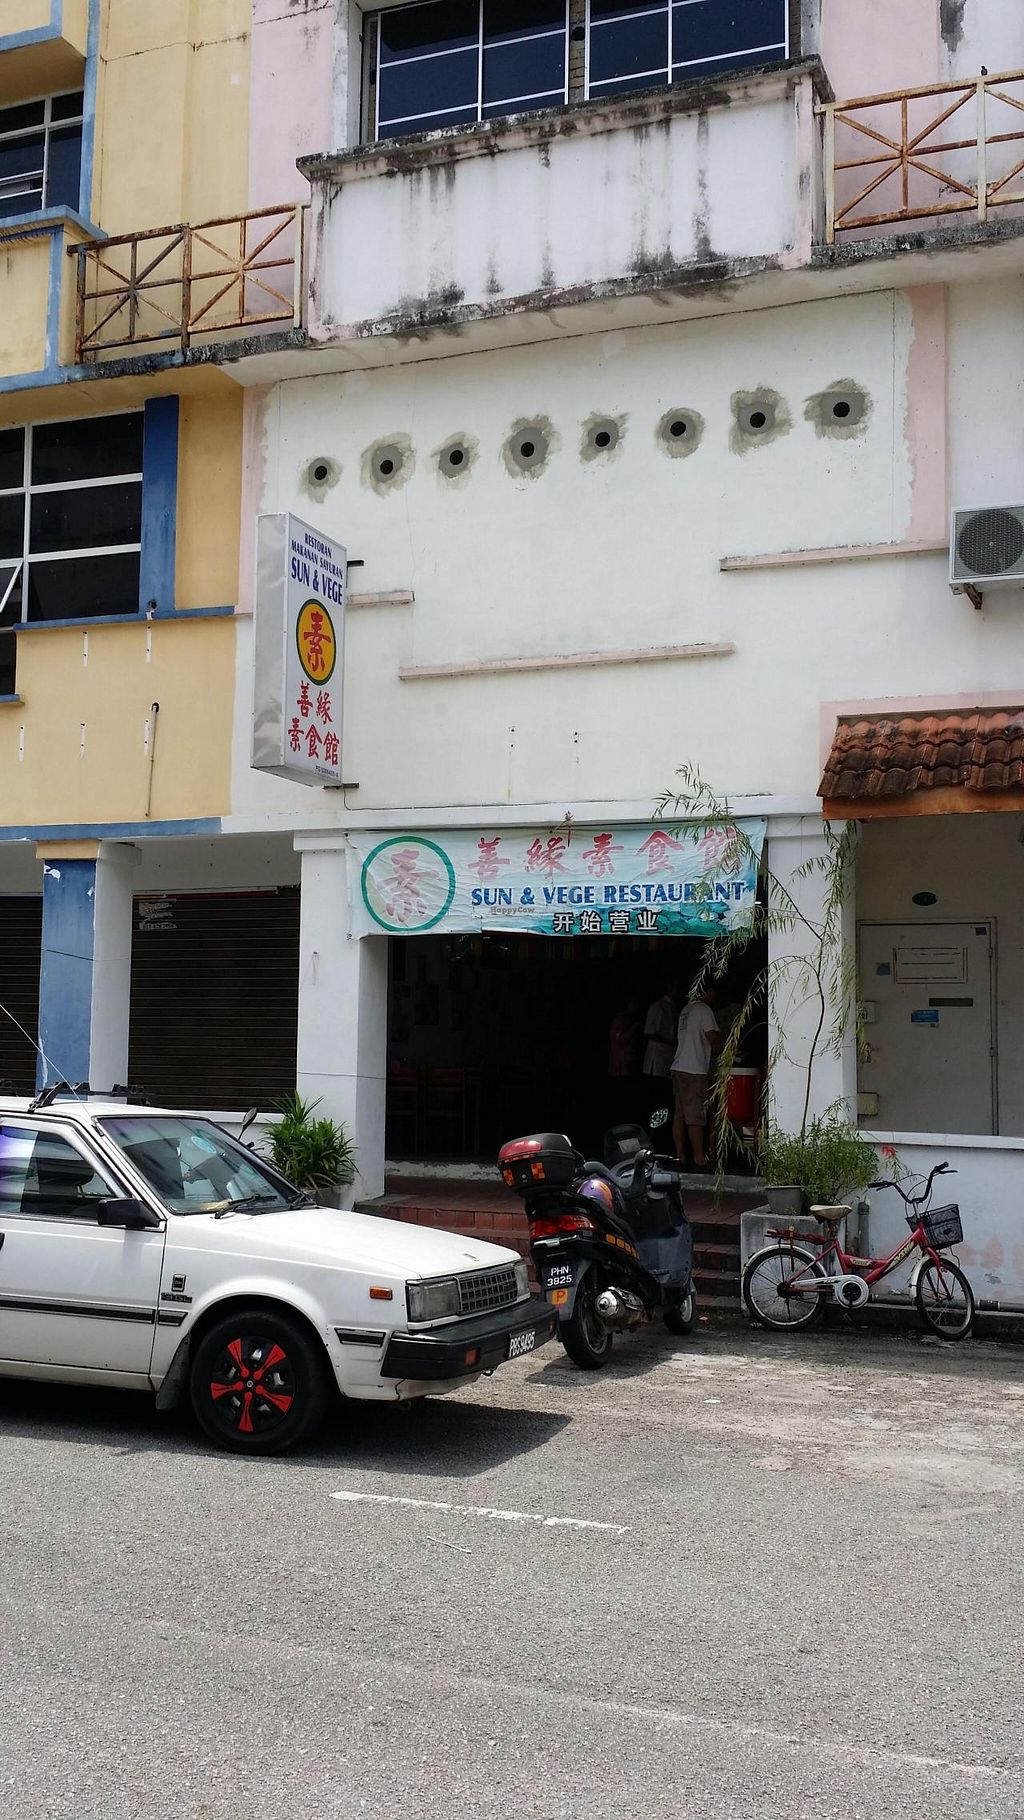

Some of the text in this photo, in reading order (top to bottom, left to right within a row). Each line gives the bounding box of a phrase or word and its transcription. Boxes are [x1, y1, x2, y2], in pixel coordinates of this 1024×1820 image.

[291, 540, 343, 580] MAKANAN SAYURAN
[304, 533, 332, 559] RESTORAN
[291, 556, 343, 605] SUN & VEGE
[303, 611, 331, 672] 素
[288, 717, 340, 766] 素食館
[382, 848, 440, 923] 素
[471, 887, 512, 905] SUN
[520, 887, 535, 905] &
[543, 886, 595, 905] VEGE
[553, 911, 660, 933] 开始营业
[547, 1274, 573, 1287] 3825
[550, 1265, 569, 1277] PHN
